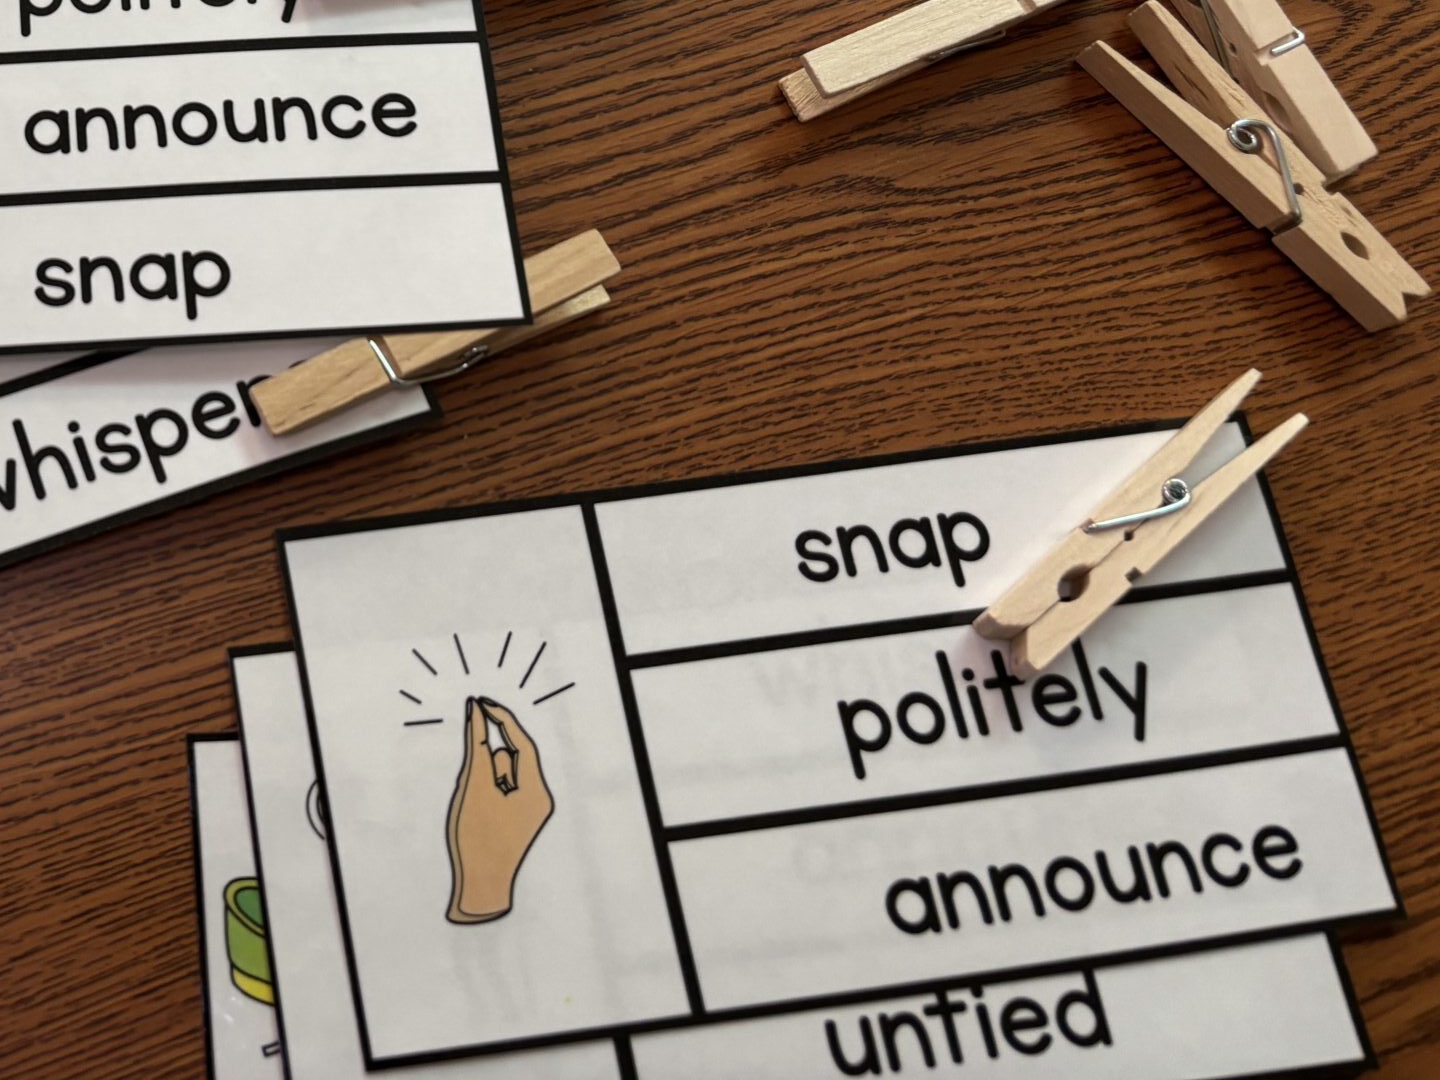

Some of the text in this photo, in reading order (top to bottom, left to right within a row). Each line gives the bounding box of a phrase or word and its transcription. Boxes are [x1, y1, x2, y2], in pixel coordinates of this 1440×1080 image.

[24, 93, 418, 155] announce
[34, 251, 232, 321] snap
[795, 510, 991, 588] snap
[836, 637, 1148, 781] politely
[884, 824, 1304, 935] announce
[824, 970, 1113, 1077] untied
